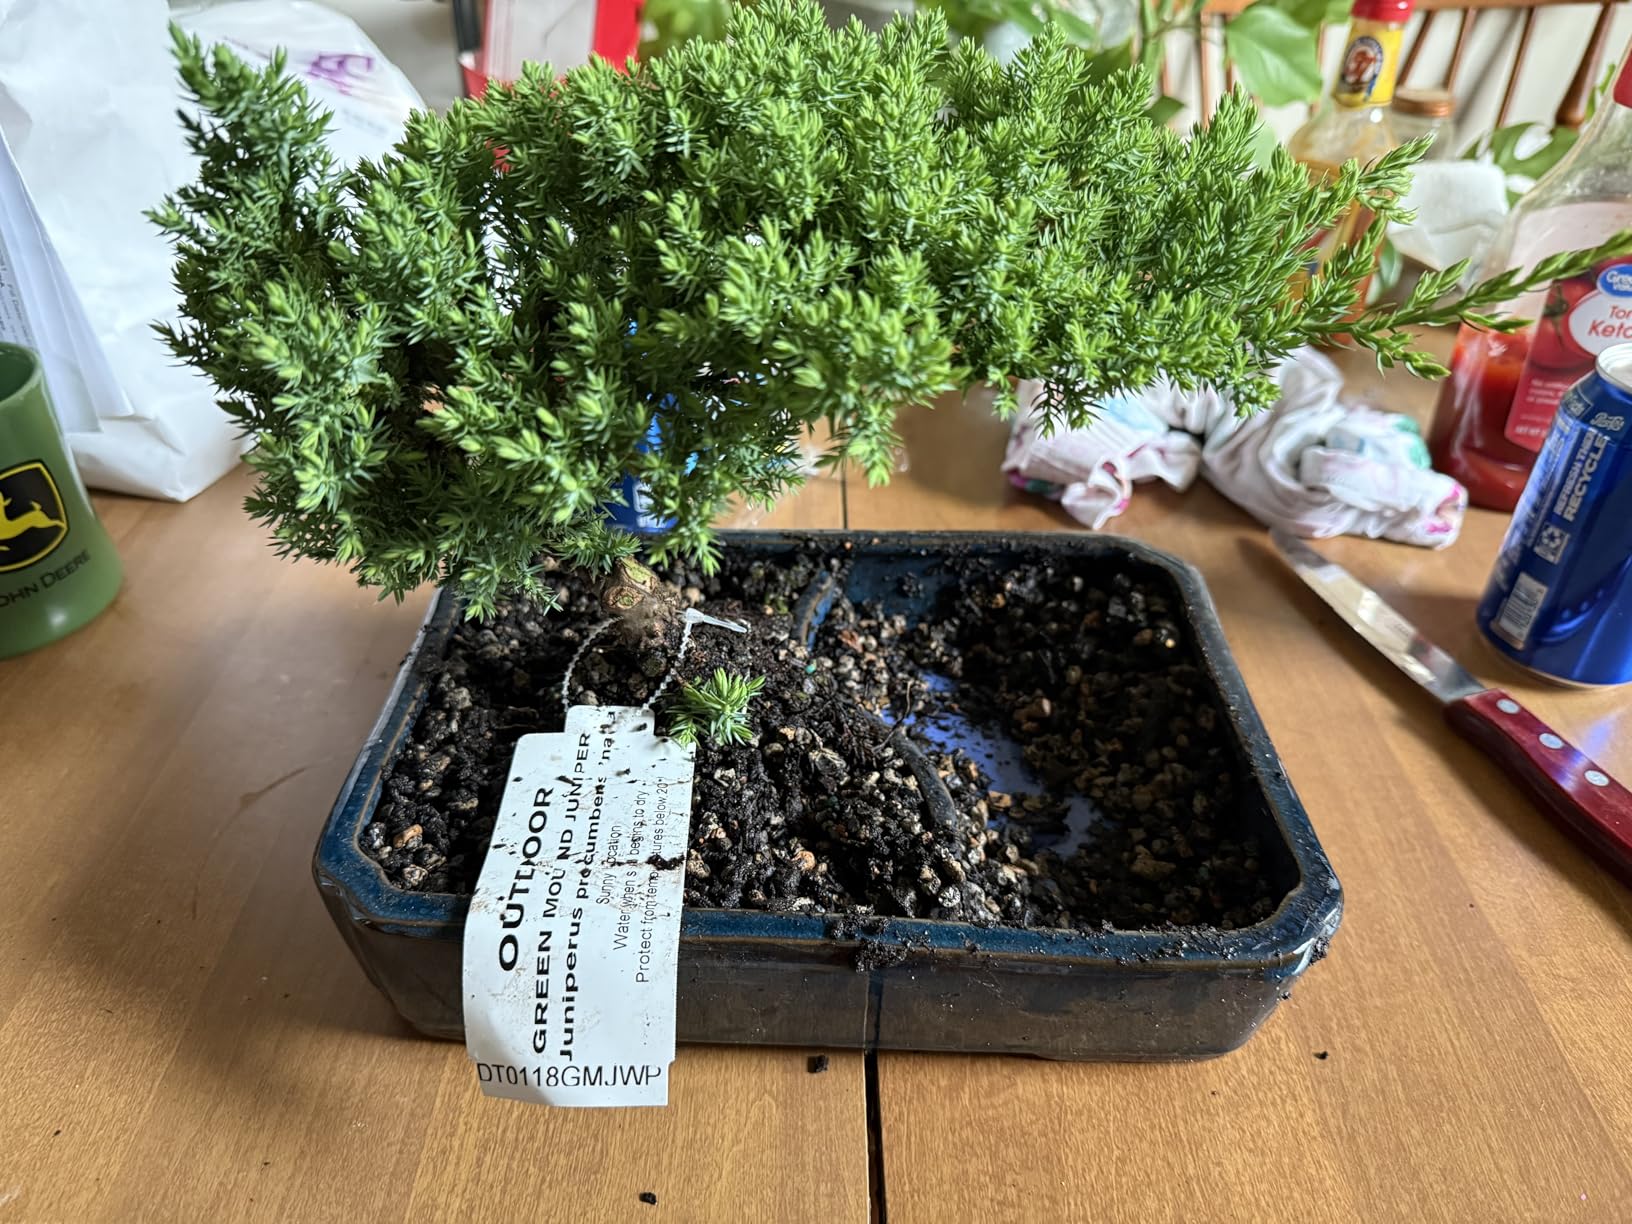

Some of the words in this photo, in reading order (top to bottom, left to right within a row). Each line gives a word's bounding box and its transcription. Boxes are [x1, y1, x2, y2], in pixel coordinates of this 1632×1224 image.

[1562, 433, 1609, 521] RECYCLE
[40, 549, 91, 589] DEERE
[631, 808, 645, 818] to
[634, 790, 650, 806] dry
[653, 797, 667, 826] below
[627, 821, 645, 856] begins
[499, 787, 554, 971] OUTDOOR
[646, 829, 664, 898] temptures
[533, 930, 553, 1054] GREEN
[543, 829, 573, 918] MOUND
[565, 732, 591, 822] JUNIPER
[595, 873, 617, 905] Sunny
[620, 880, 636, 908] when
[560, 906, 584, 1062] Juniperus
[576, 777, 607, 899] procumbens
[613, 909, 631, 950] Water
[641, 901, 658, 924] from
[635, 926, 653, 983] Protect
[477, 1062, 662, 1087] DT0118GMJWP
